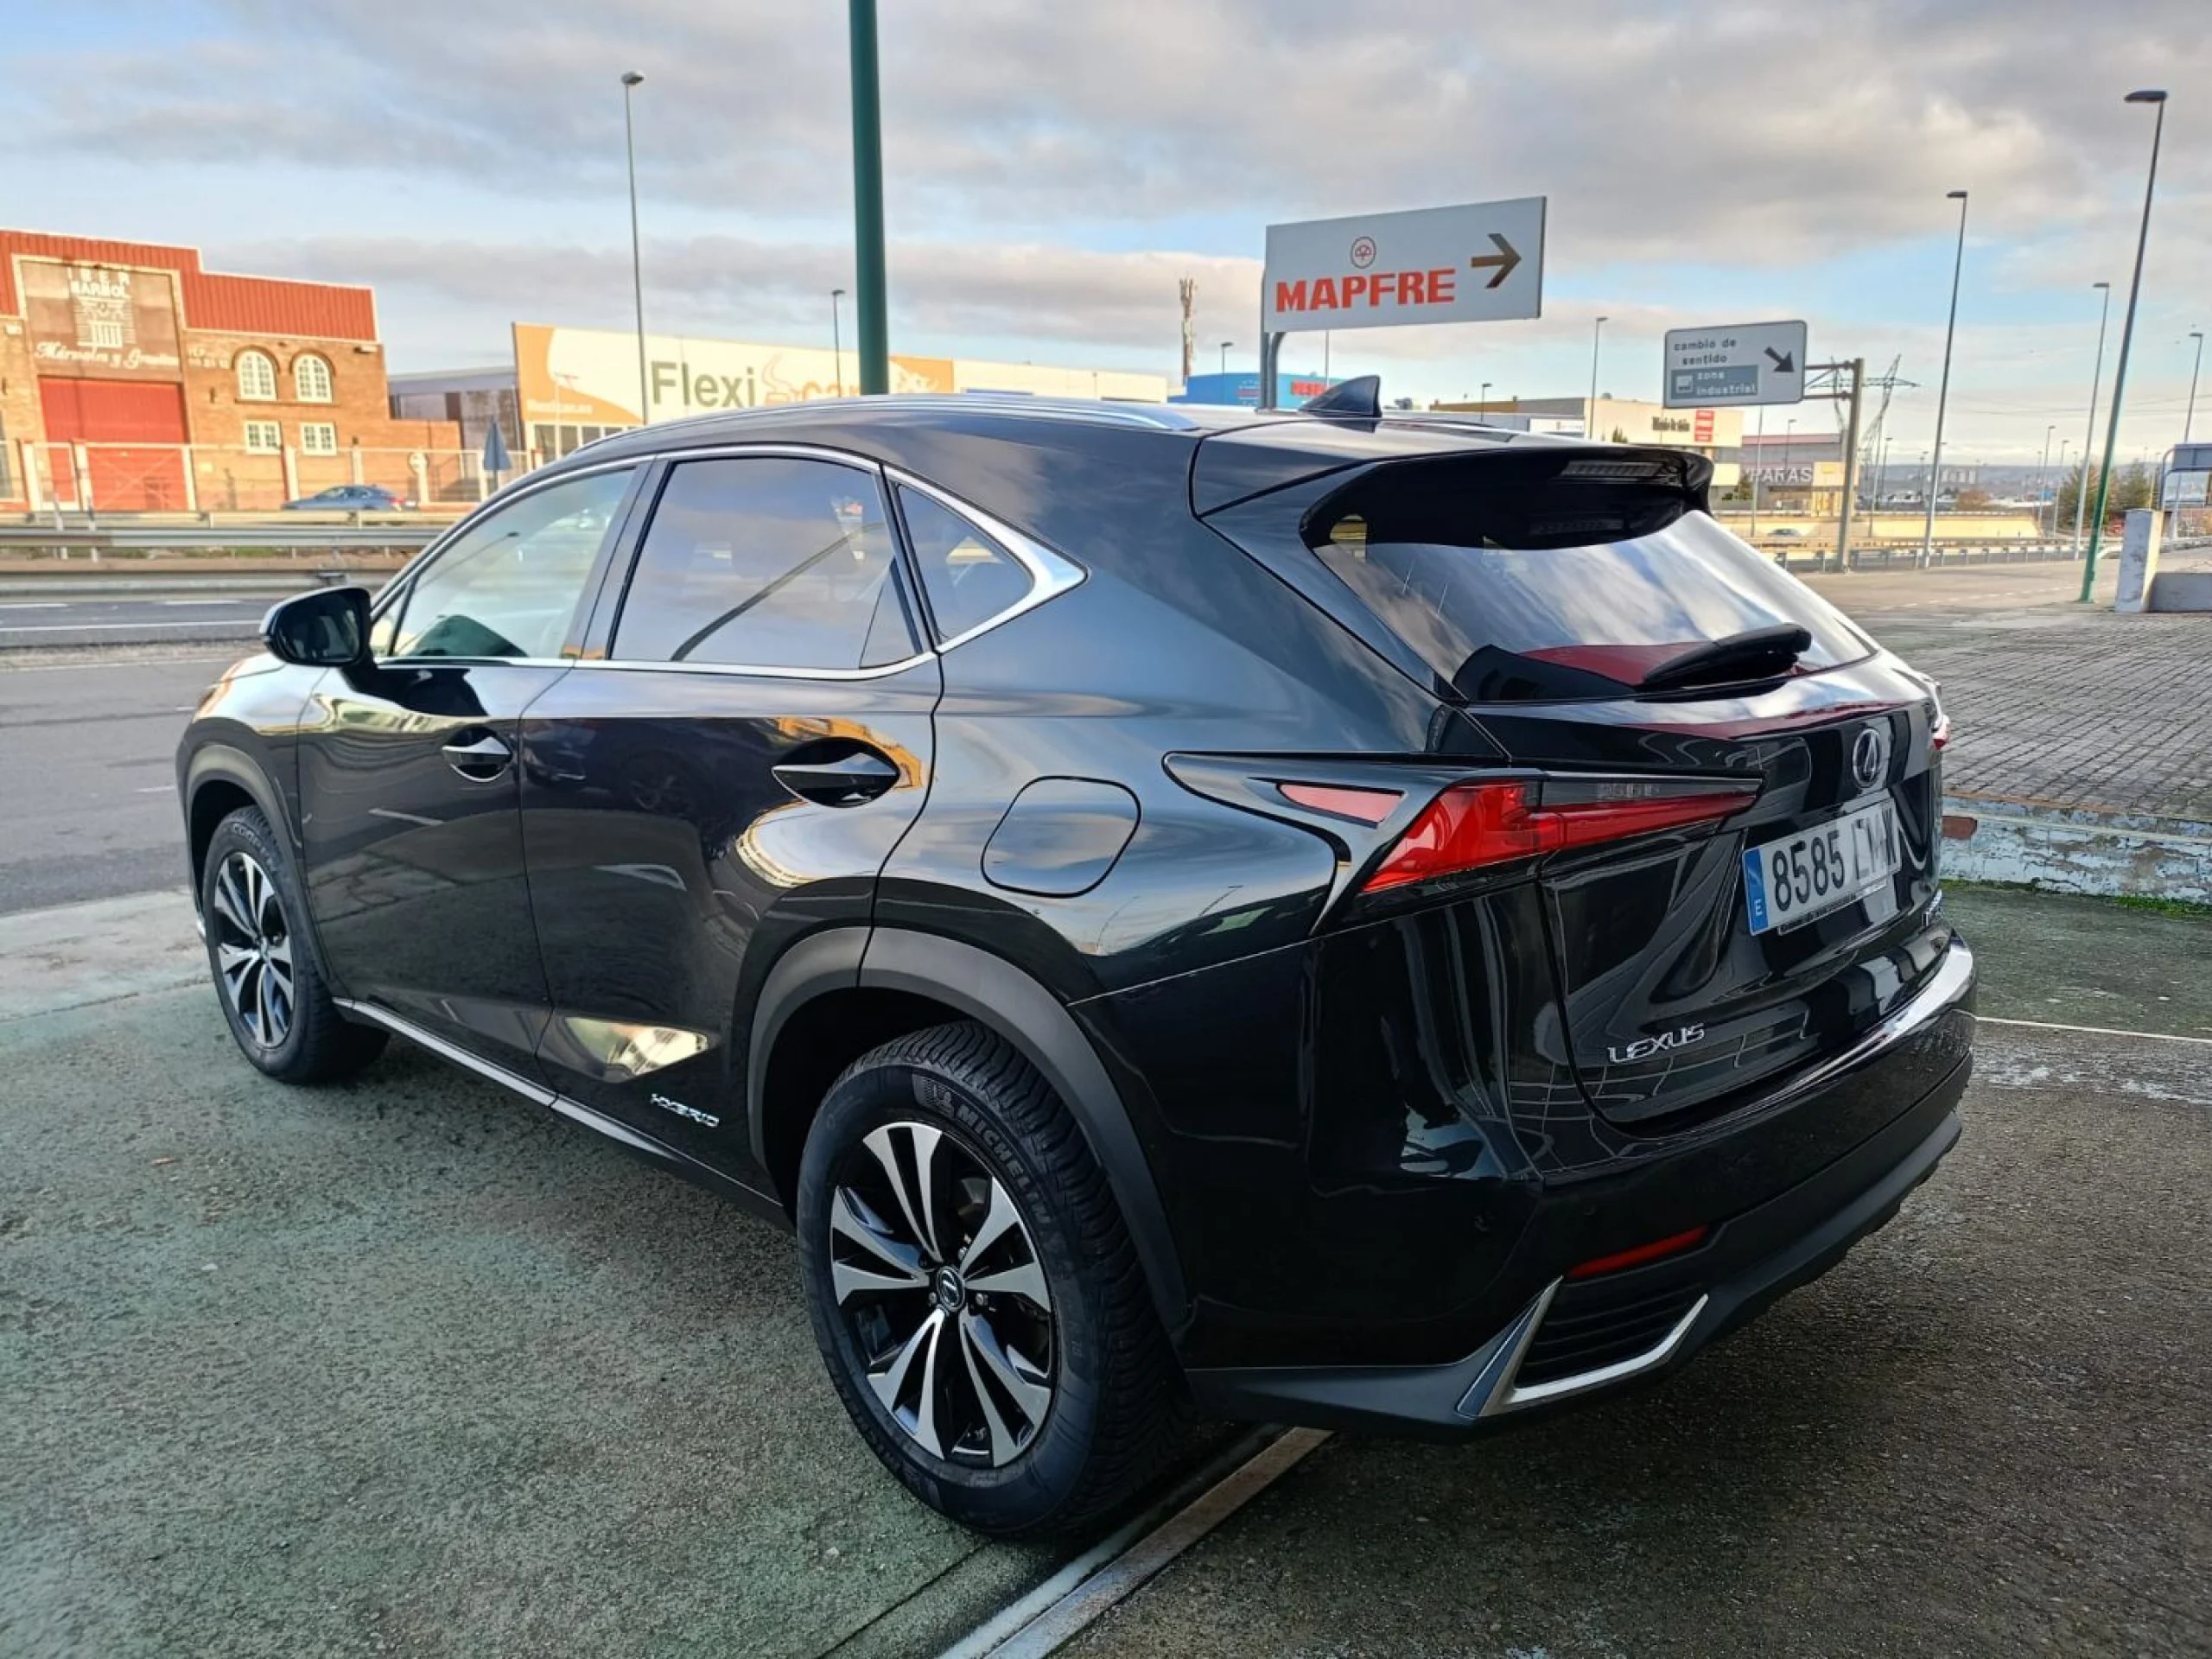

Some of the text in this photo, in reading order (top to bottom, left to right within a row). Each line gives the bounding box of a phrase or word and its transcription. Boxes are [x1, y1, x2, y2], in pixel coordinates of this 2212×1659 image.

[1276, 269, 1456, 312] MAPFRE
[1674, 337, 1737, 351] cambio de
[1682, 353, 1727, 365] sentido
[651, 360, 756, 408] Flexi
[1695, 382, 1758, 396] industrial
[1772, 828, 1846, 912] 8585
[1754, 899, 1763, 917] E
[1607, 1022, 1705, 1063] LEXUS
[957, 1103, 1052, 1224] MICHELIN
